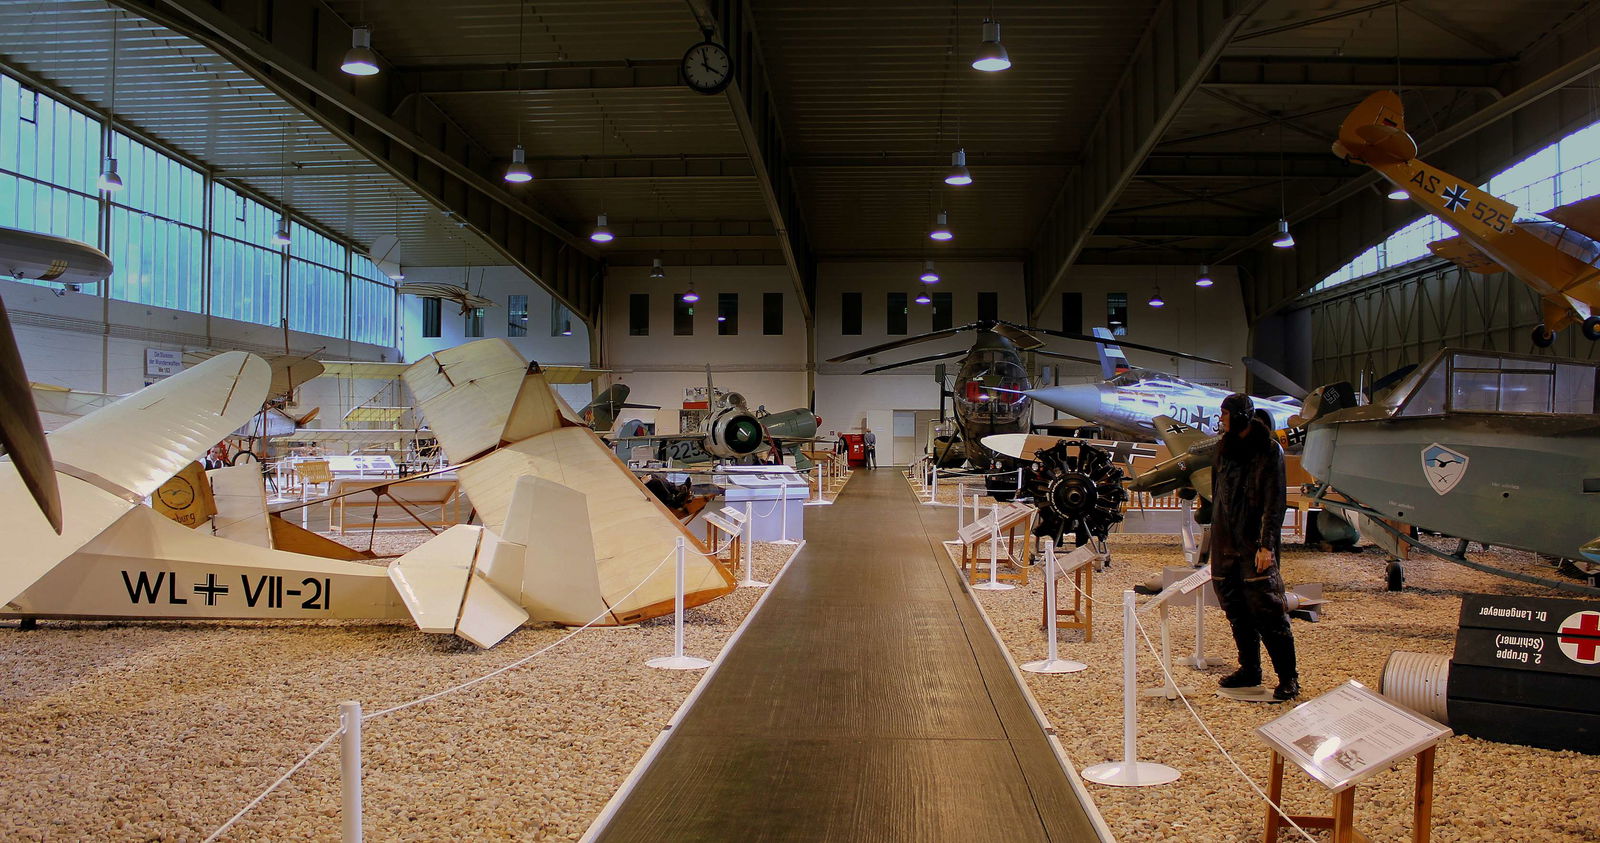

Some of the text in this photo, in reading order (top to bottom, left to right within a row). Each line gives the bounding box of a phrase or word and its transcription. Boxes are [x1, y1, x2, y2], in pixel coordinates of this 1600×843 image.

[1409, 169, 1441, 195] AS
[1471, 201, 1510, 233] 525
[1169, 404, 1188, 424] 20
[173, 512, 196, 526] burg
[121, 570, 188, 605] WL
[241, 574, 331, 610] VII-21
[1479, 606, 1547, 622] Dr. Langemeyer
[1495, 633, 1544, 652] (Schirmer)
[1496, 649, 1542, 664] 2. Gruppe
